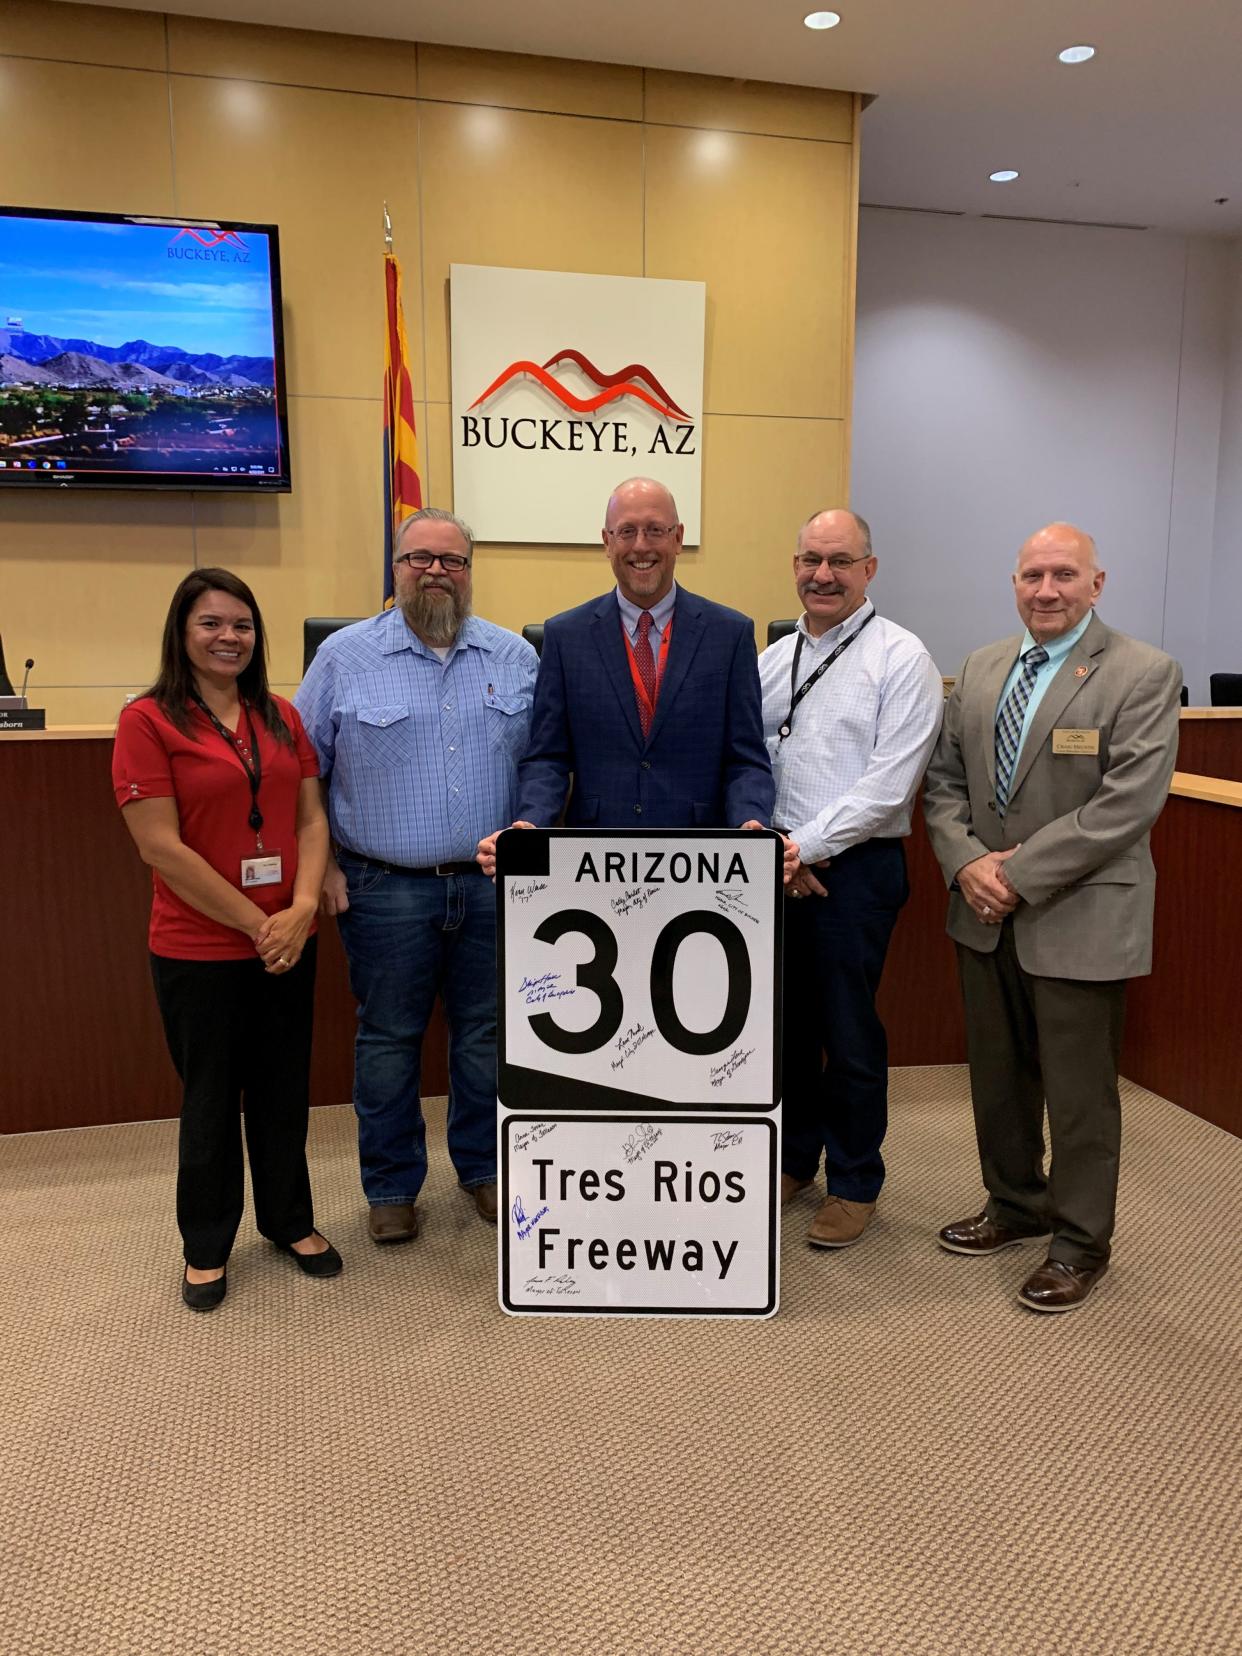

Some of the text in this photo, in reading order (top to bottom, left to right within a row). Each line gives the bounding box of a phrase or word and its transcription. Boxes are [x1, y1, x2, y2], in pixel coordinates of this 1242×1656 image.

[167, 247, 250, 263] BUCKEYE, AZ
[461, 416, 696, 456] BUCKEYE, AZ
[575, 852, 750, 883] ARIZONA
[527, 909, 752, 1055] 30
[532, 1159, 746, 1203] Tres Rios
[538, 1228, 739, 1280] Freeway
